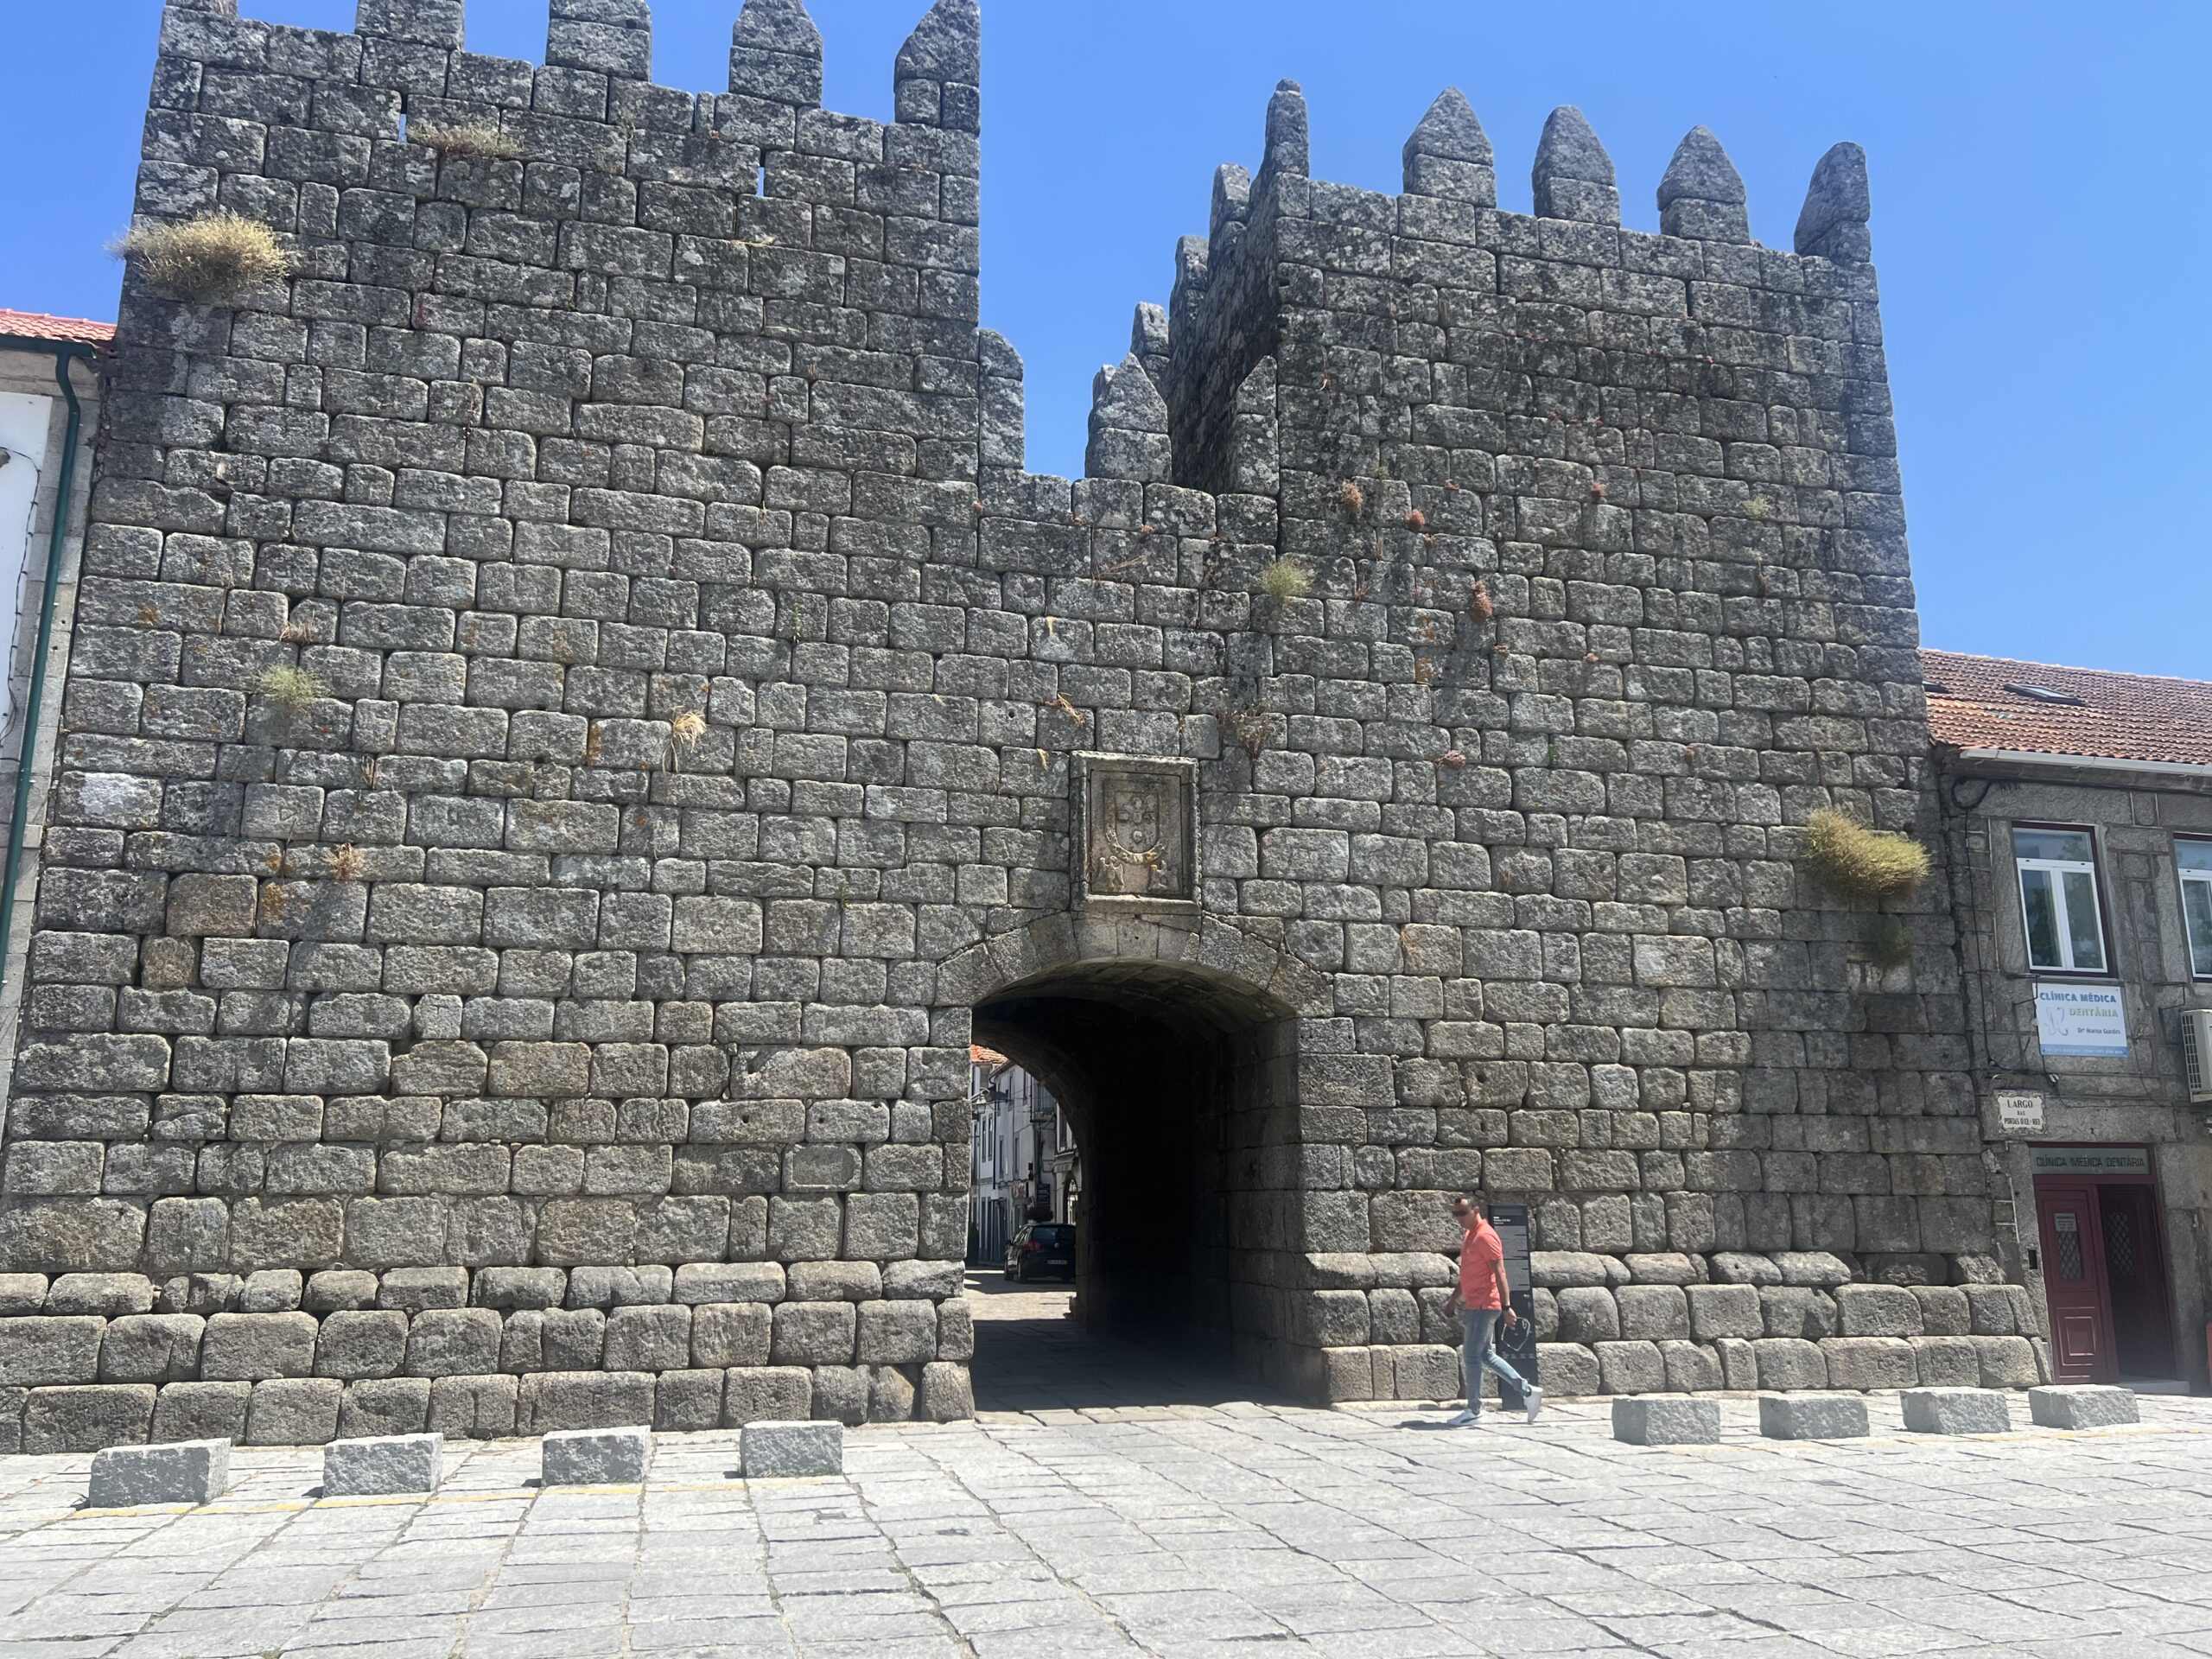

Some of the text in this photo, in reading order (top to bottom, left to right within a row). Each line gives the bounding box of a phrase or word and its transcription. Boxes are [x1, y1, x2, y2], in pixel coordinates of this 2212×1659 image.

[2039, 991, 2117, 1003] CLÍNICA MÉDICA
[2069, 1007, 2119, 1018] DENTÁRIA
[2007, 1099, 2033, 1109] LARGO
[2036, 1154, 2145, 1167] CLÍNICA MÉDICA DENTÁRIA
